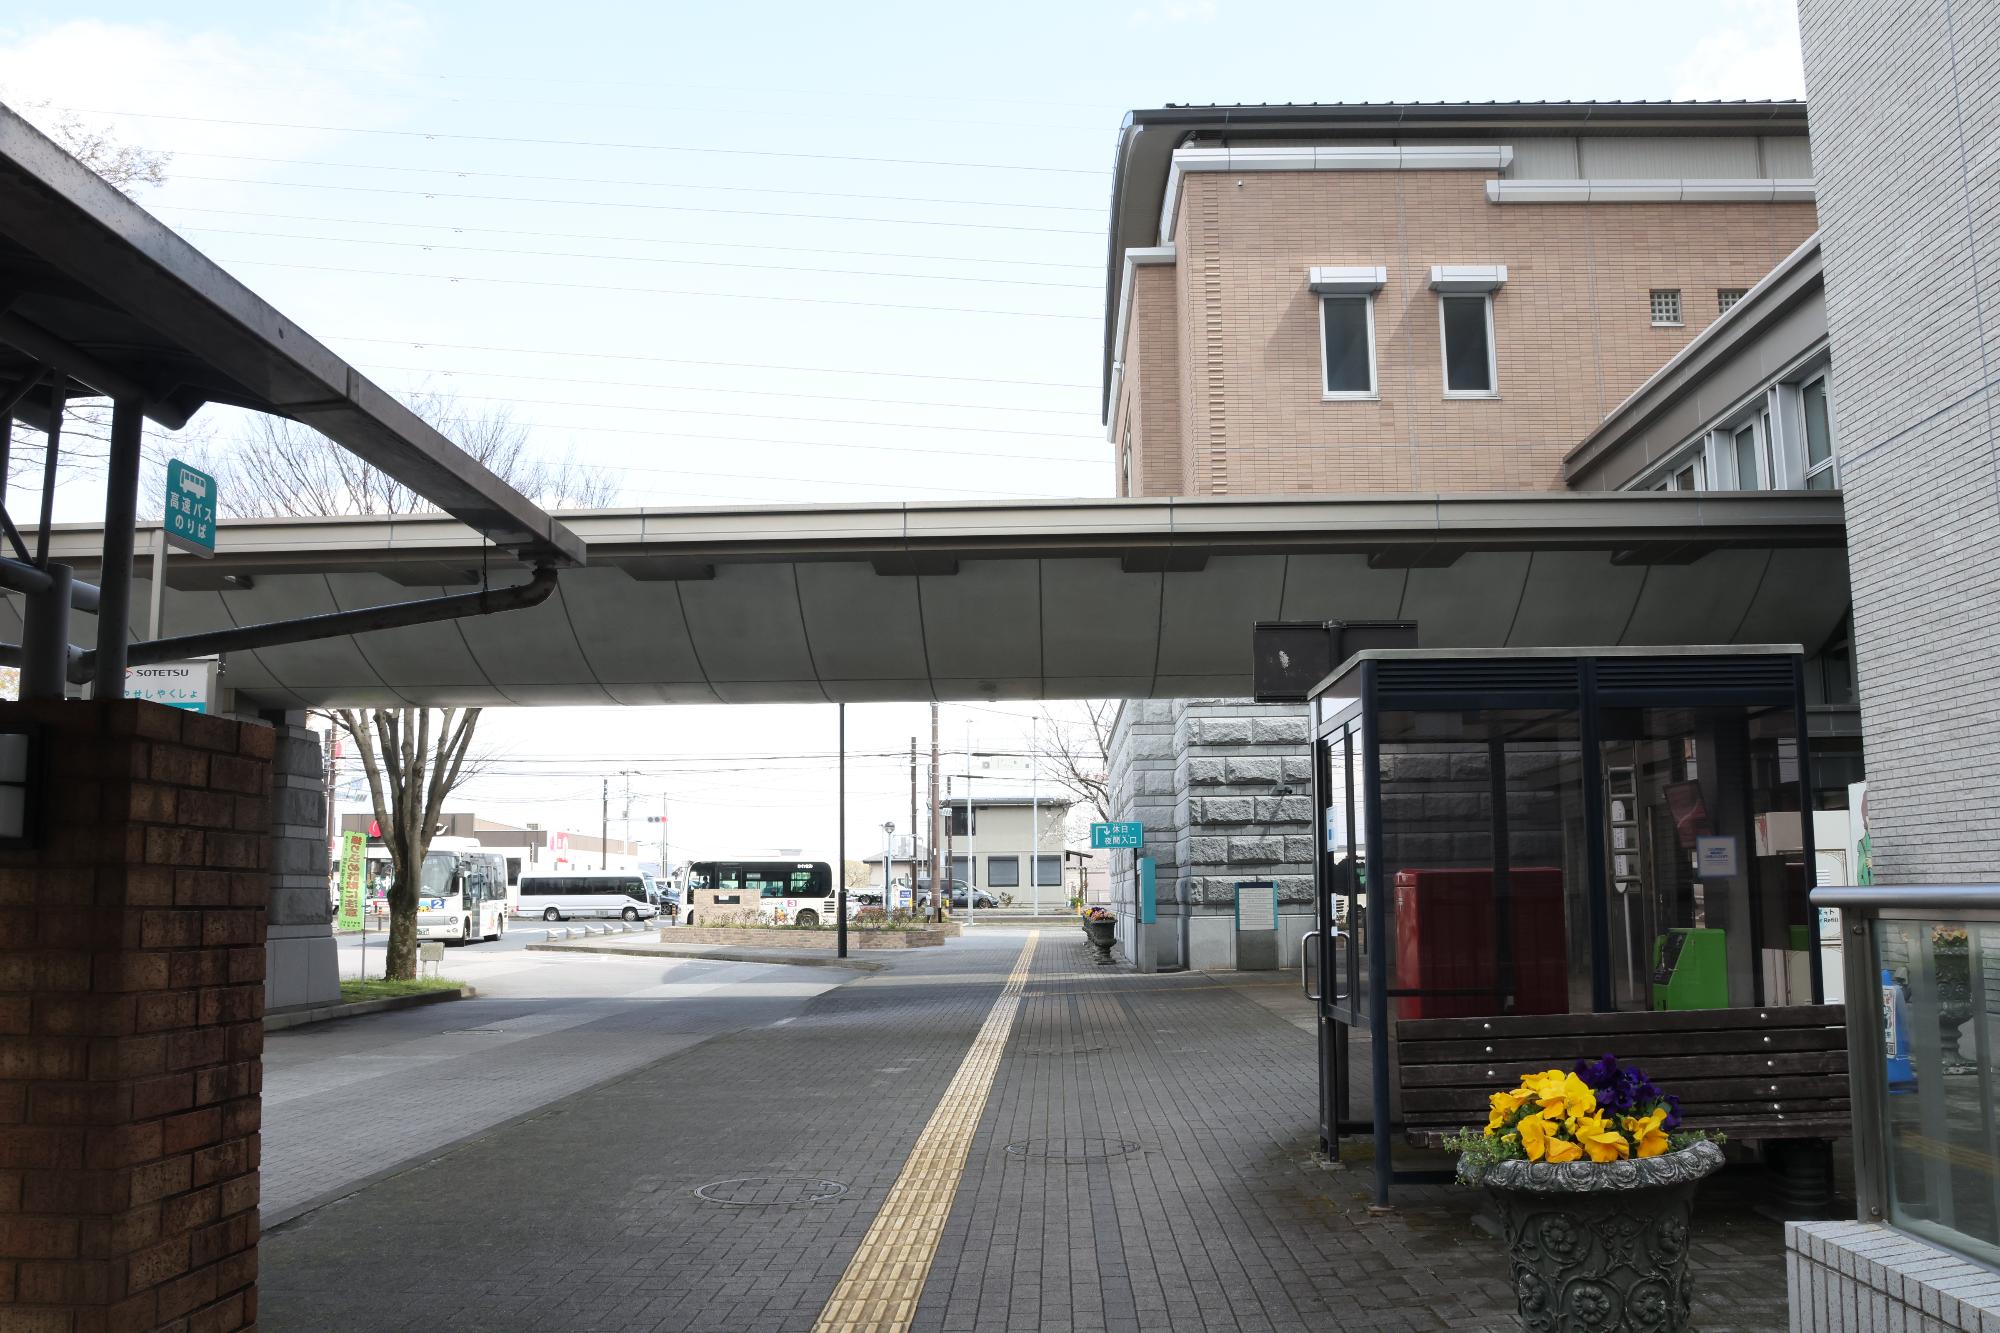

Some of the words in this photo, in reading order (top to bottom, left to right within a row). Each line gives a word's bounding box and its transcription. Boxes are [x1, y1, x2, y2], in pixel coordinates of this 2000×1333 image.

[170, 491, 212, 523] 高速バス
[175, 514, 207, 539] のりば
[136, 669, 189, 677] SOTETSU
[1104, 836, 1137, 845] 夜間入口
